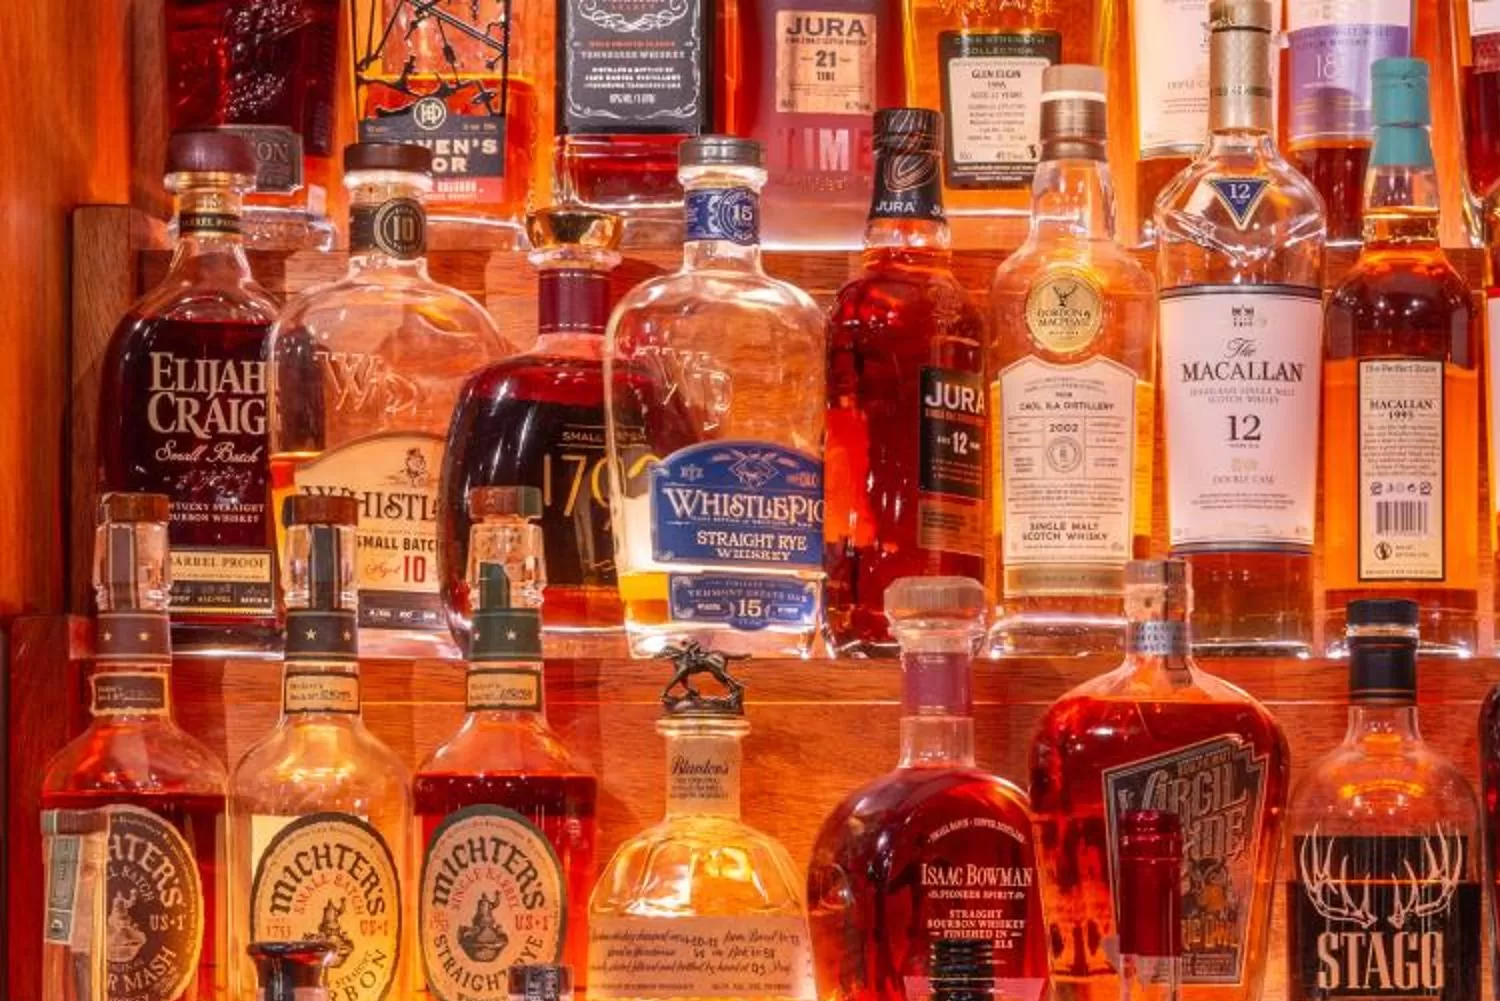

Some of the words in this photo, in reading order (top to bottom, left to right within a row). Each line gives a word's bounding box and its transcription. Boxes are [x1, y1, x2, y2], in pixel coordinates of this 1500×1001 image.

[787, 18, 866, 37] JURA
[815, 50, 837, 68] 21
[1228, 184, 1251, 198] 12
[876, 200, 915, 213] JURA
[149, 351, 266, 401] ELIJAH
[1182, 361, 1304, 384] MACALLAN
[925, 381, 985, 415] JURA
[148, 392, 266, 438] CRAIG
[1227, 414, 1262, 442] 12
[952, 431, 968, 455] 12
[697, 530, 774, 548] STRAIGHT
[778, 535, 806, 551] RYE
[717, 548, 791, 561] WHISKEY
[403, 556, 426, 582] 10
[735, 600, 761, 617] 15
[433, 836, 545, 909] MICHTER'S
[921, 863, 962, 886] ISAAC
[966, 864, 1034, 886] BOWMAN
[433, 932, 508, 990] STRAIGHT
[1317, 932, 1446, 990] STAGG
